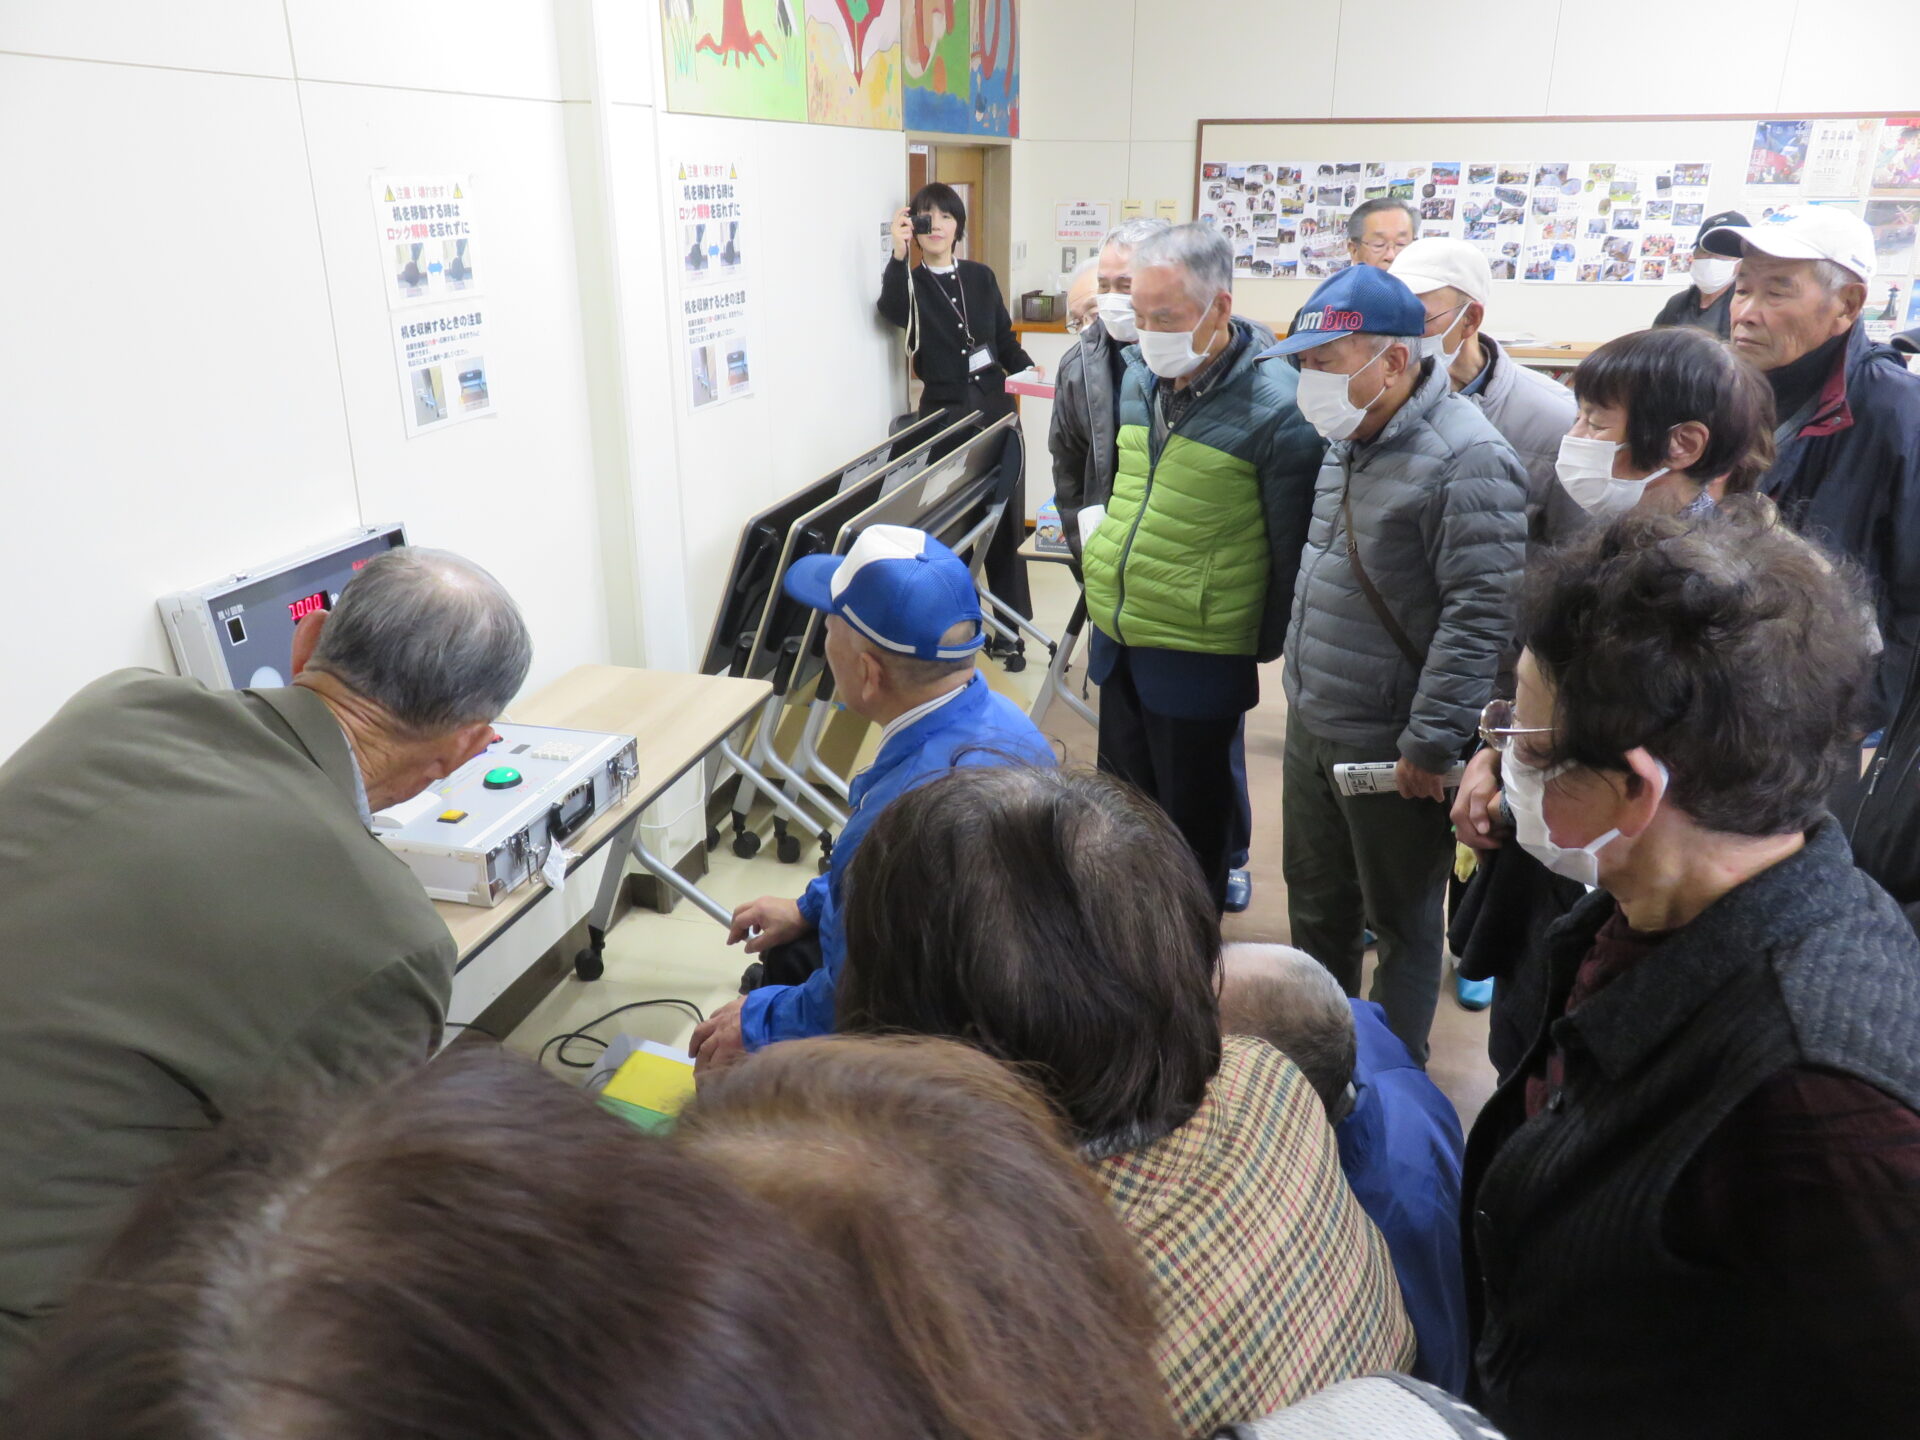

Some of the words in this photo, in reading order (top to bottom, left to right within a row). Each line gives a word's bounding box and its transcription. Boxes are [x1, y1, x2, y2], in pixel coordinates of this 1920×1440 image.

[683, 184, 734, 200] 机を移動する時は
[392, 203, 460, 221] 机を移動する時は
[679, 202, 741, 219] ロック解除を忘れずに
[386, 221, 470, 240] ロック解除を忘れずに
[684, 290, 746, 314] 机を収納するときの注意
[400, 312, 482, 339] 机を収納するときの注意
[1296, 305, 1363, 331] umbro
